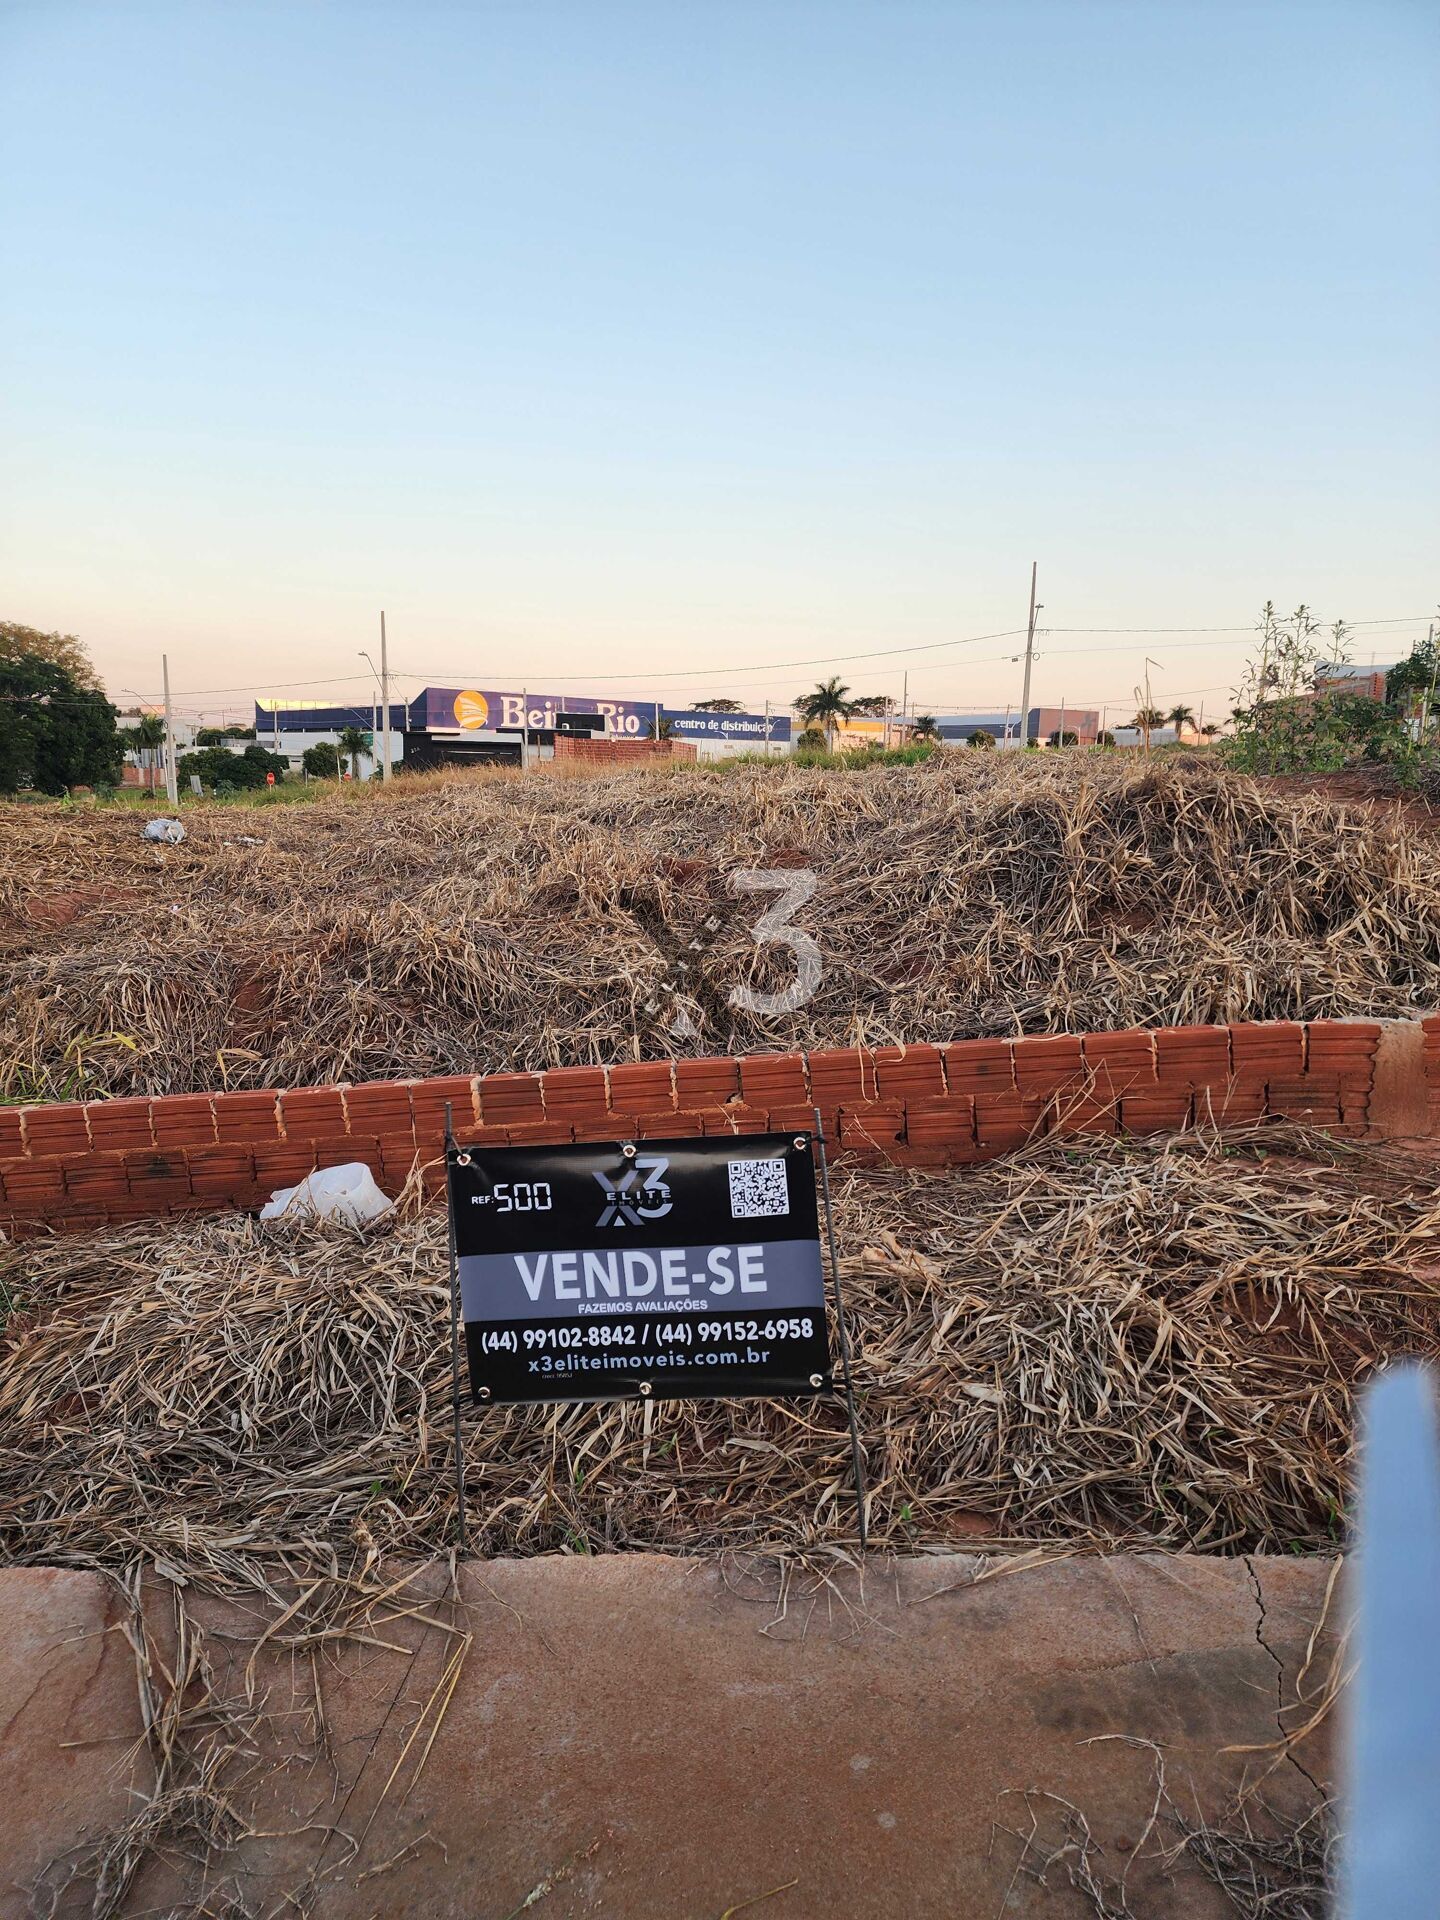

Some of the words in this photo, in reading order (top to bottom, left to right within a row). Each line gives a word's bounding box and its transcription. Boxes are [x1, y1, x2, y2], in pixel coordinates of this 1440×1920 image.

[501, 696, 556, 730] Bei
[597, 703, 640, 733] Rio
[674, 719, 706, 730] centro
[707, 719, 719, 730] de
[471, 1195, 495, 1205] REF:
[493, 1182, 552, 1212] 500
[606, 1188, 672, 1200] ELITE
[513, 1246, 768, 1301] VENDE-SE
[578, 1302, 633, 1314] FAZEMOS
[635, 1298, 708, 1313] AVALIAÇÕES
[481, 1330, 518, 1354] (44)
[523, 1324, 636, 1350] 99102-8842
[655, 1322, 692, 1347] (44)
[697, 1318, 814, 1343] 99152-6958
[528, 1346, 770, 1372] x3eliteimoveis.com.br
